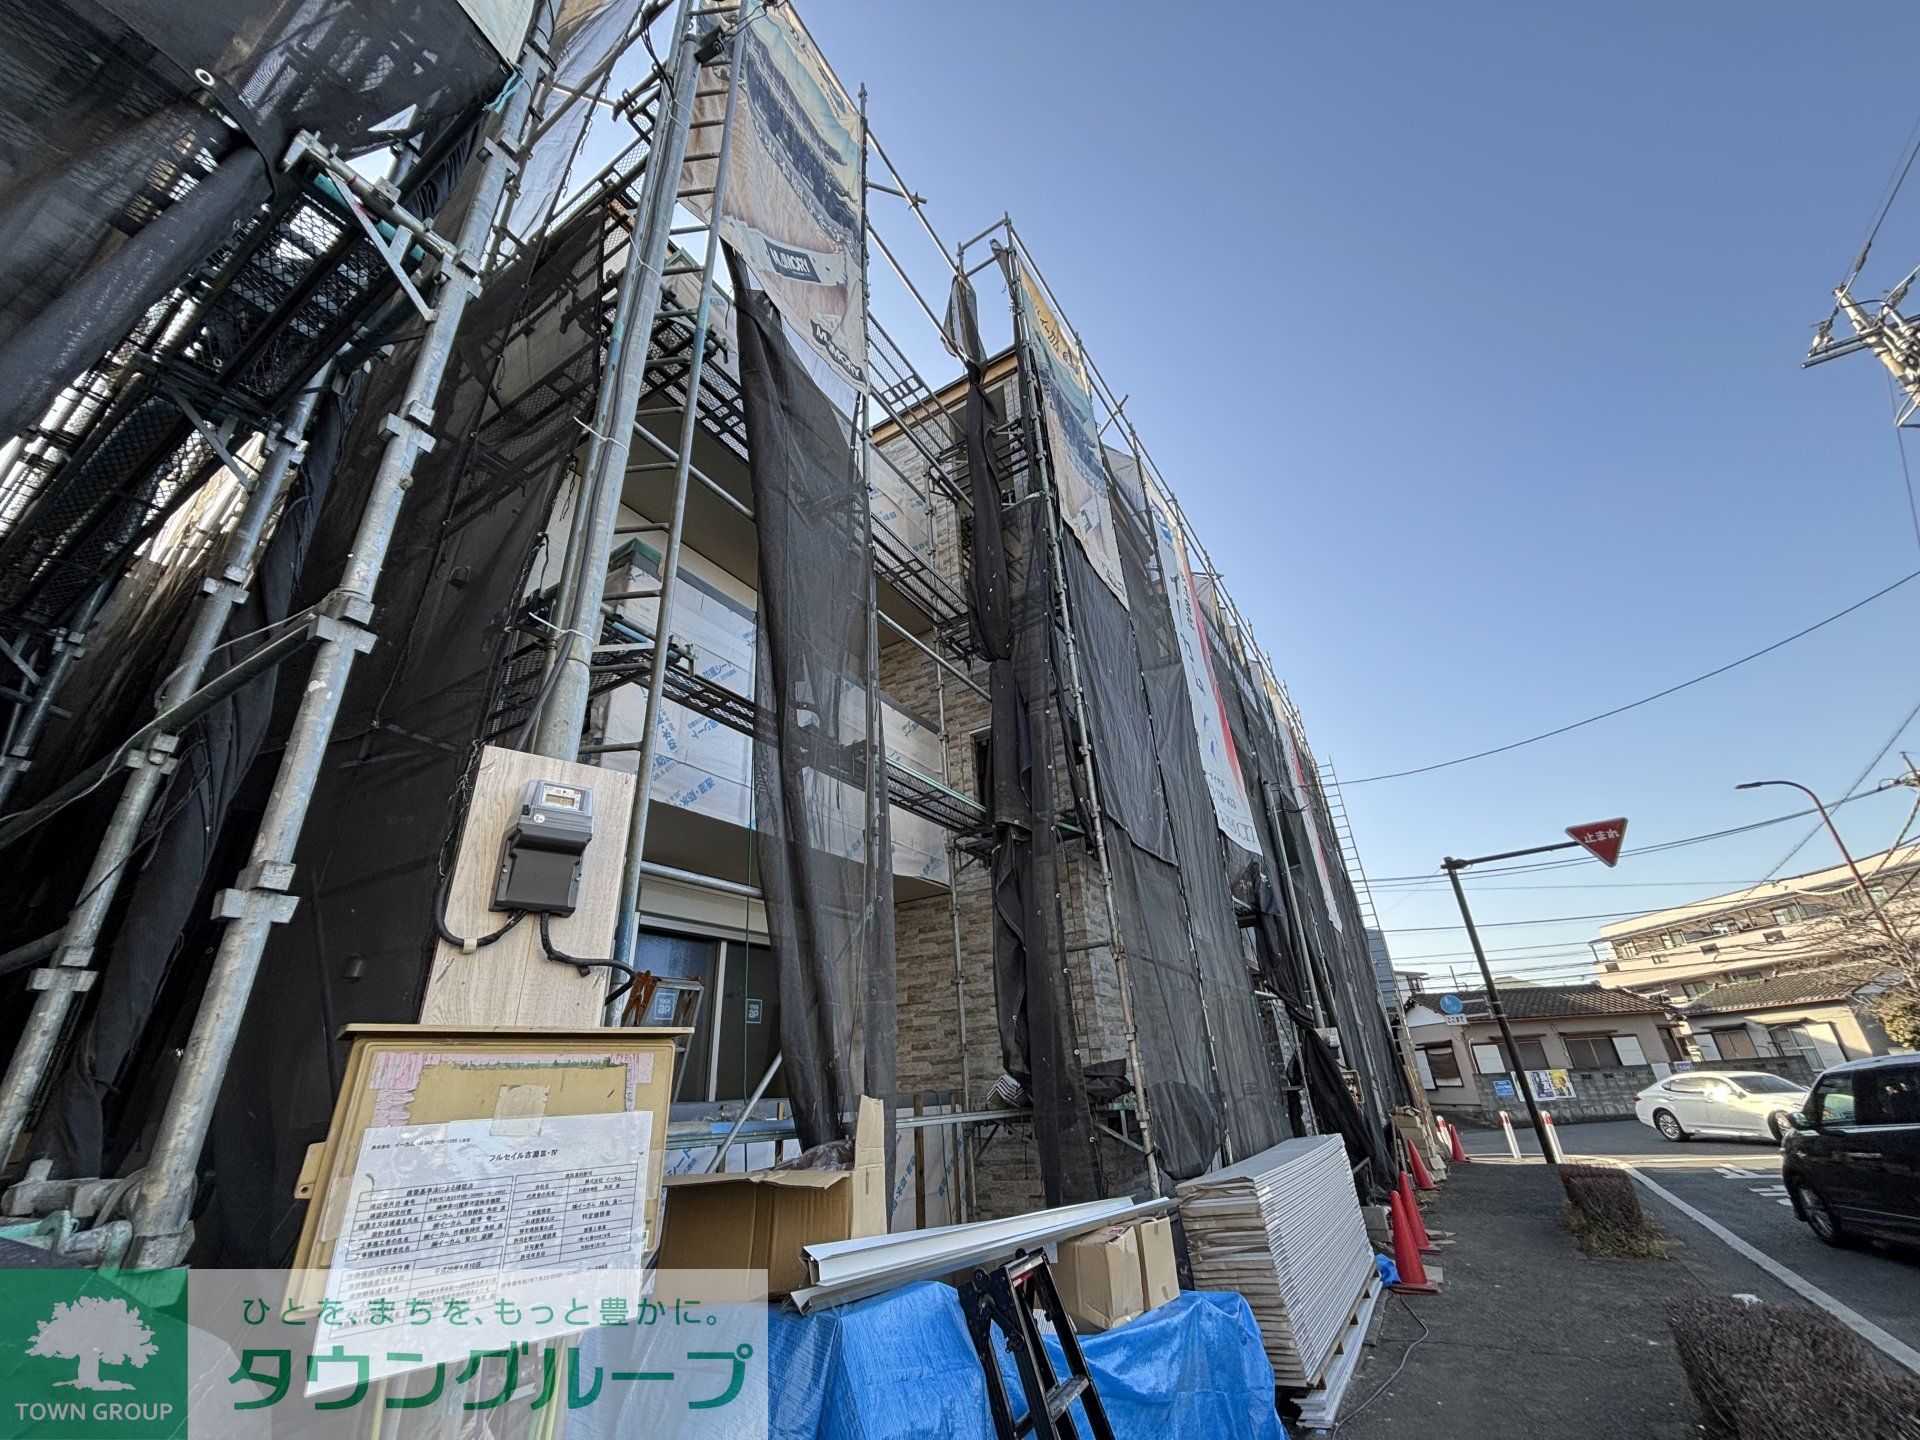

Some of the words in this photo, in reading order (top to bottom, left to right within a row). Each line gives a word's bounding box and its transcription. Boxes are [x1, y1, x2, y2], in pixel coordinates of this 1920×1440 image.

[816, 324, 861, 378] MMORY
[1584, 829, 1620, 843] 止まれ
[658, 1005, 670, 1015] ap
[748, 1010, 759, 1019] ap
